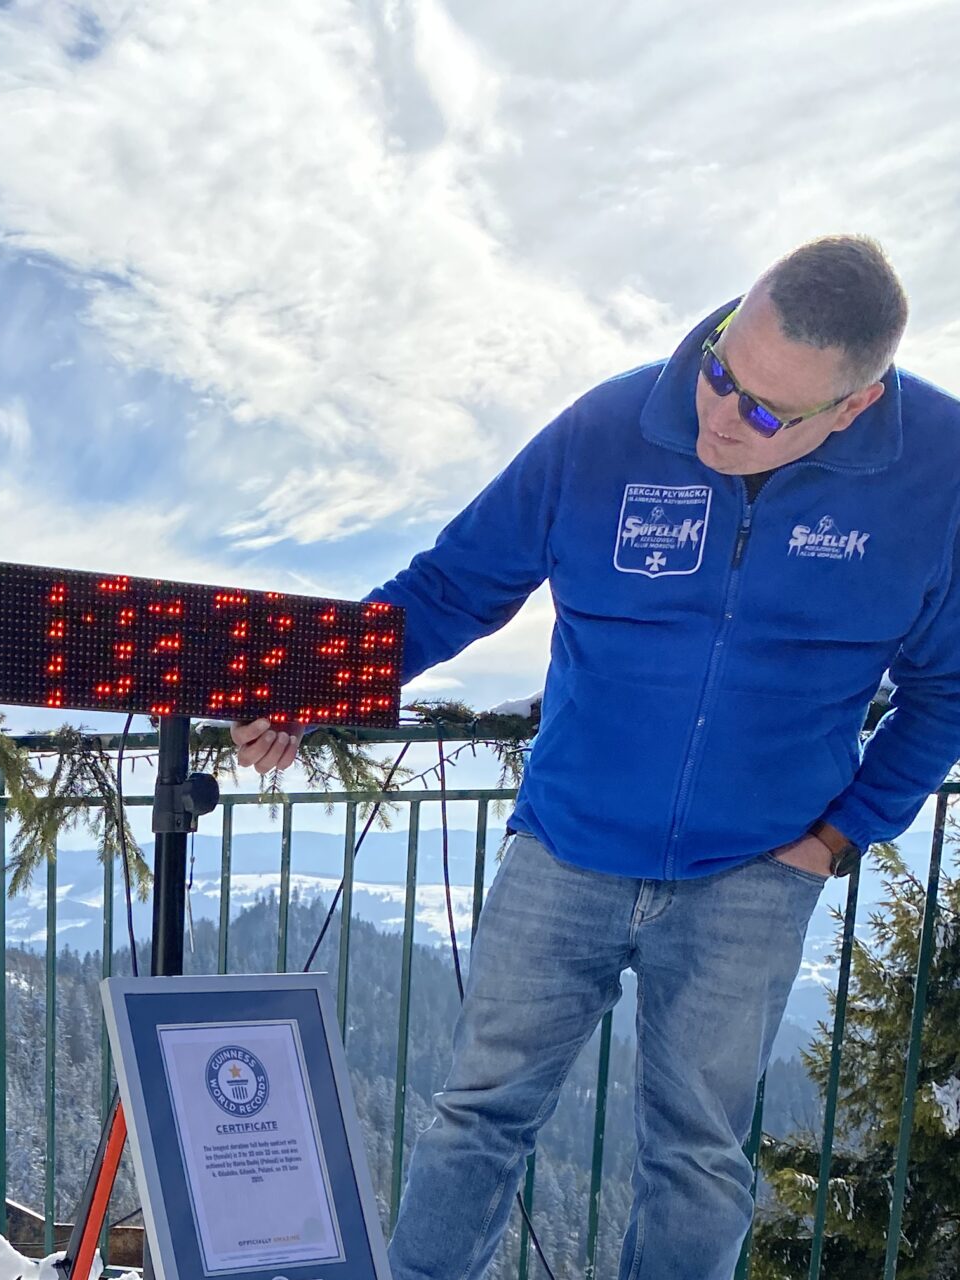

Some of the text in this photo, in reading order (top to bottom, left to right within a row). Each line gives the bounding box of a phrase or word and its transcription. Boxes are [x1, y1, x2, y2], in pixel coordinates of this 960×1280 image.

[628, 488, 707, 498] SEKCJA PŁYWACKA
[787, 525, 870, 560] SOPELEK
[212, 1050, 256, 1070] GUINNESS
[210, 1076, 266, 1113] WORLD RECORDS
[216, 1121, 278, 1134] CERTIFICATE
